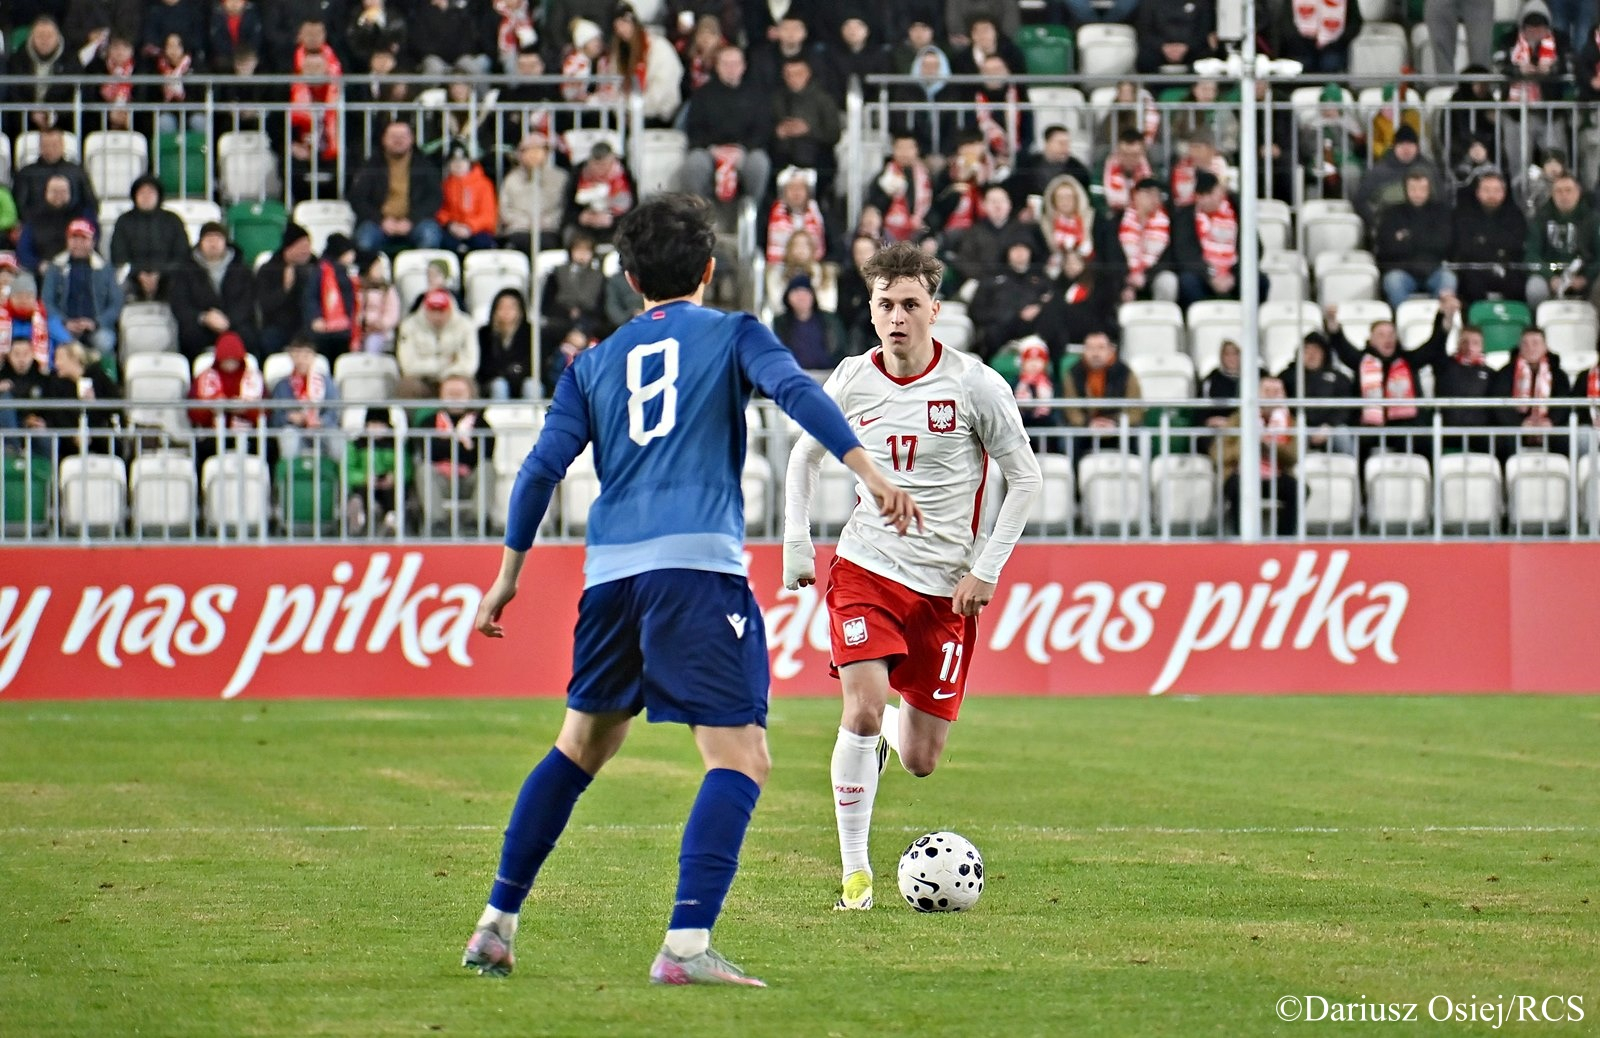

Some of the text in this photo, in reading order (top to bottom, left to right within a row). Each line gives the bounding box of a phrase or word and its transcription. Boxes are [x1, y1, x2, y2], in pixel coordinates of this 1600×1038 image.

[626, 337, 680, 446] 8
[886, 435, 918, 472] 17
[61, 584, 238, 668] nas
[221, 551, 483, 700] piłka
[988, 549, 1409, 696] nas piłka
